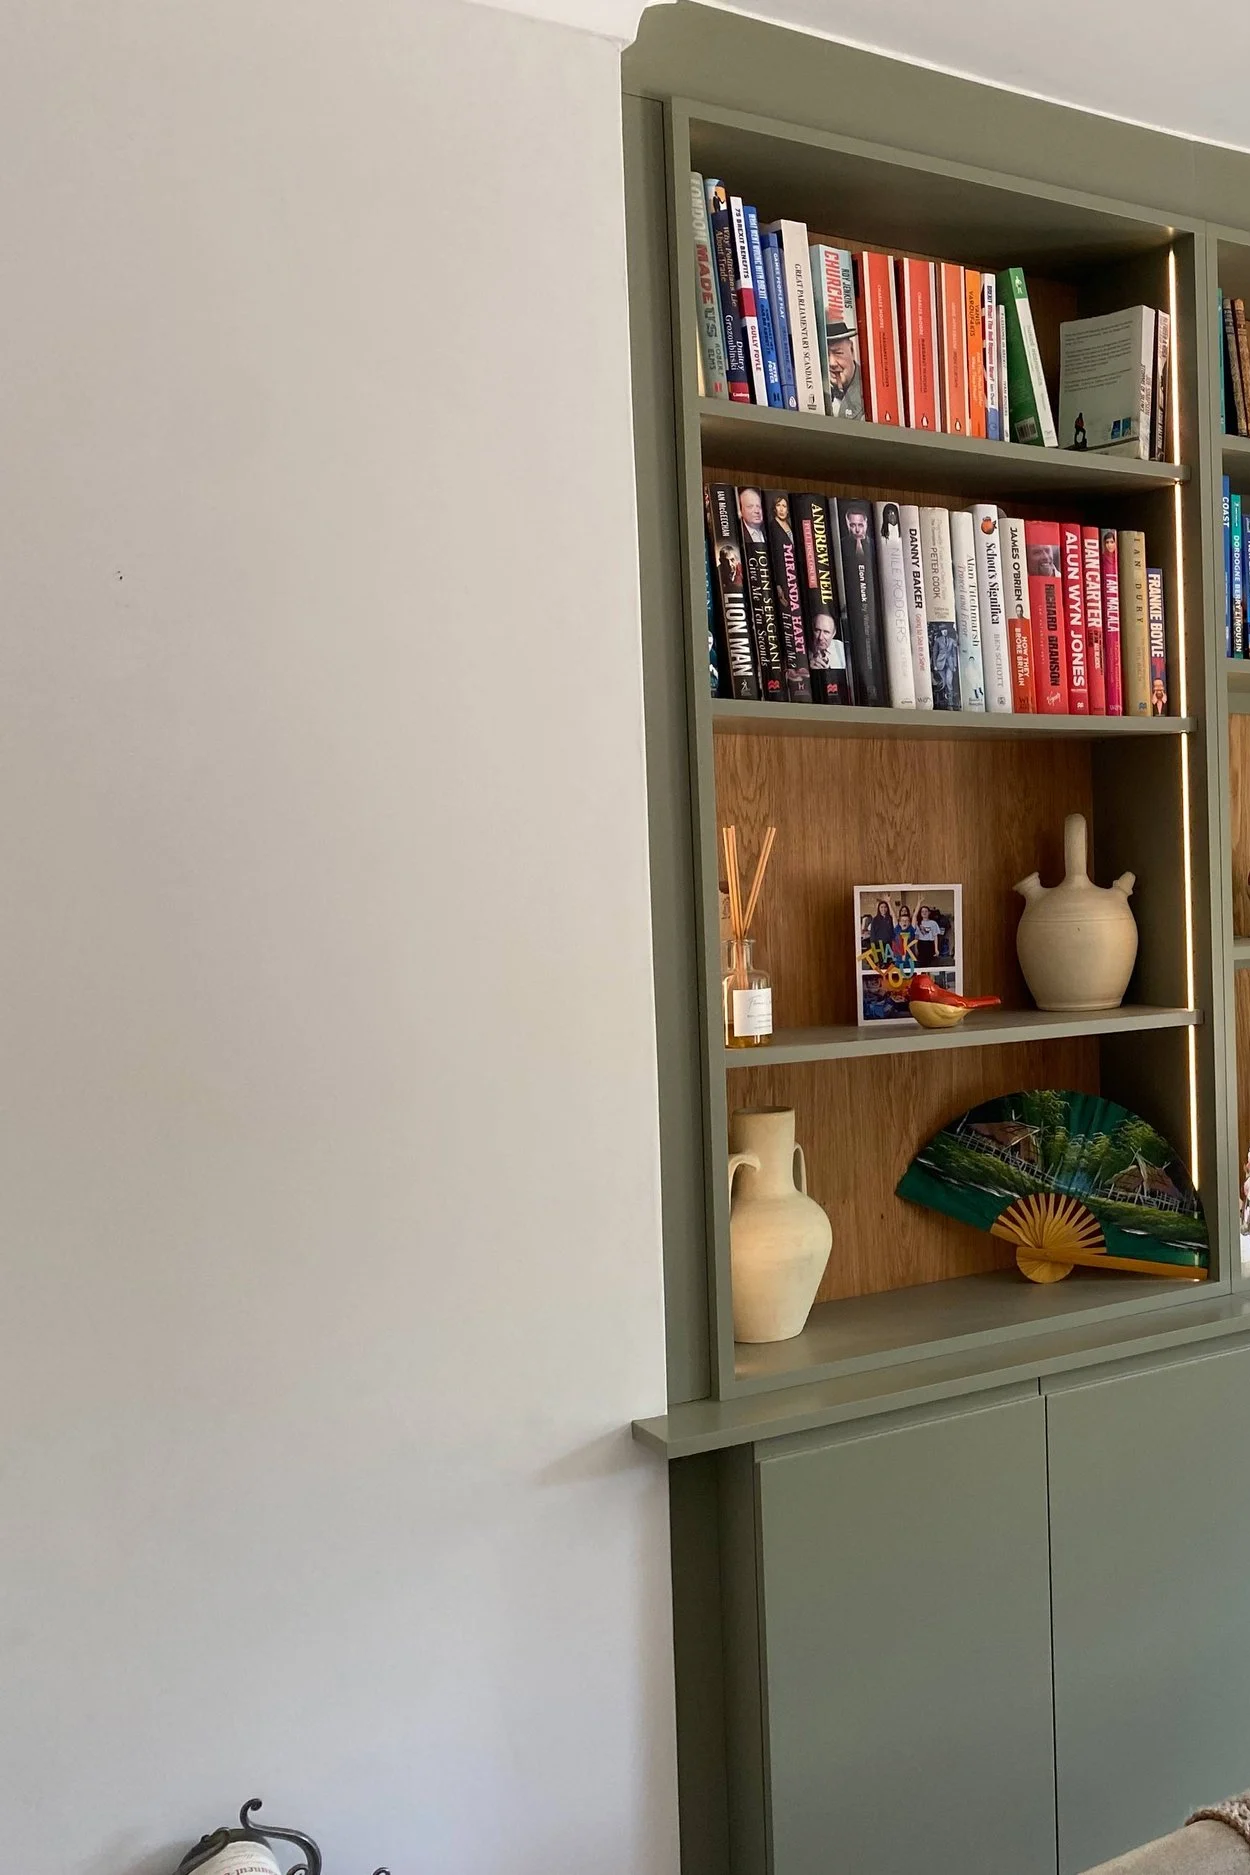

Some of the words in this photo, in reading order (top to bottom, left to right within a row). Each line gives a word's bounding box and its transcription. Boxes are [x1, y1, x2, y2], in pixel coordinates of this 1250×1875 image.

[690, 177, 706, 243] LONDON
[735, 208, 742, 217] 75
[715, 230, 726, 255] About
[722, 226, 732, 244] Why
[736, 218, 745, 243] BREXIT
[696, 244, 714, 304] MADE
[718, 256, 728, 282] Trade
[724, 247, 736, 292] Politicians
[740, 245, 749, 279] BENEFITS
[794, 263, 804, 288] GREAT
[842, 268, 850, 281] ROY
[730, 293, 738, 307] Lie
[756, 280, 768, 300] BREXIT
[843, 282, 853, 309] JENKINS
[704, 306, 717, 338] US
[750, 325, 759, 347] GULLY
[797, 289, 810, 350] PARLIAMENTARY
[708, 348, 717, 370] ELMS
[725, 314, 738, 370] Grozoubinski
[735, 340, 746, 371] Dmitry
[753, 348, 762, 372] FOYLE
[803, 351, 813, 389] SCANDALS
[717, 490, 726, 501] IAN
[1222, 496, 1230, 528] COAST
[718, 502, 730, 537] McGEECHAN
[811, 503, 829, 568] ANDREW
[909, 528, 920, 568] DANNY
[930, 547, 939, 574] PETER
[985, 542, 998, 579] Schott's
[1009, 527, 1019, 559] JAMES
[1065, 531, 1079, 580] ALUN
[1084, 538, 1100, 570] DAN
[1133, 537, 1141, 568] IAN
[1233, 535, 1241, 582] DORDOGNE
[748, 557, 759, 581] Give
[755, 550, 772, 590] JOHN
[858, 565, 866, 581] Elon
[888, 547, 900, 575] NILE
[966, 554, 975, 580] Alan
[752, 585, 761, 601] Me
[818, 569, 834, 605] NEIL
[859, 582, 868, 602] Musk
[912, 570, 923, 609] BAKER
[932, 575, 941, 599] COOK
[1013, 562, 1023, 601] O'BRIEN
[1106, 579, 1118, 594] AM
[1147, 573, 1163, 620] FRANKIE
[723, 593, 746, 634] LION
[754, 605, 765, 624] Ten
[782, 544, 800, 611] MIRANDA
[792, 616, 806, 655] HART
[892, 579, 908, 643] RODGERS
[968, 583, 980, 647] Titchmarsh
[987, 581, 1001, 625] Significa
[1044, 583, 1057, 631] RICHARD
[1067, 584, 1081, 626] WYN
[1085, 571, 1102, 628] CARTER
[1107, 597, 1119, 632] MALALA
[1135, 583, 1143, 623] DURY
[757, 629, 770, 667] Seconds
[763, 597, 782, 672] SERGEANT
[784, 631, 794, 648] Just
[993, 633, 1001, 651] BEN
[1151, 622, 1164, 658] BOYLE
[1234, 611, 1242, 652] LIMOUSIN
[726, 638, 754, 676] MAN
[995, 652, 1004, 688] SCHOTT
[1016, 655, 1025, 686] BRITAIN
[1047, 635, 1060, 686] BRANSON
[1070, 630, 1085, 687] JONES
